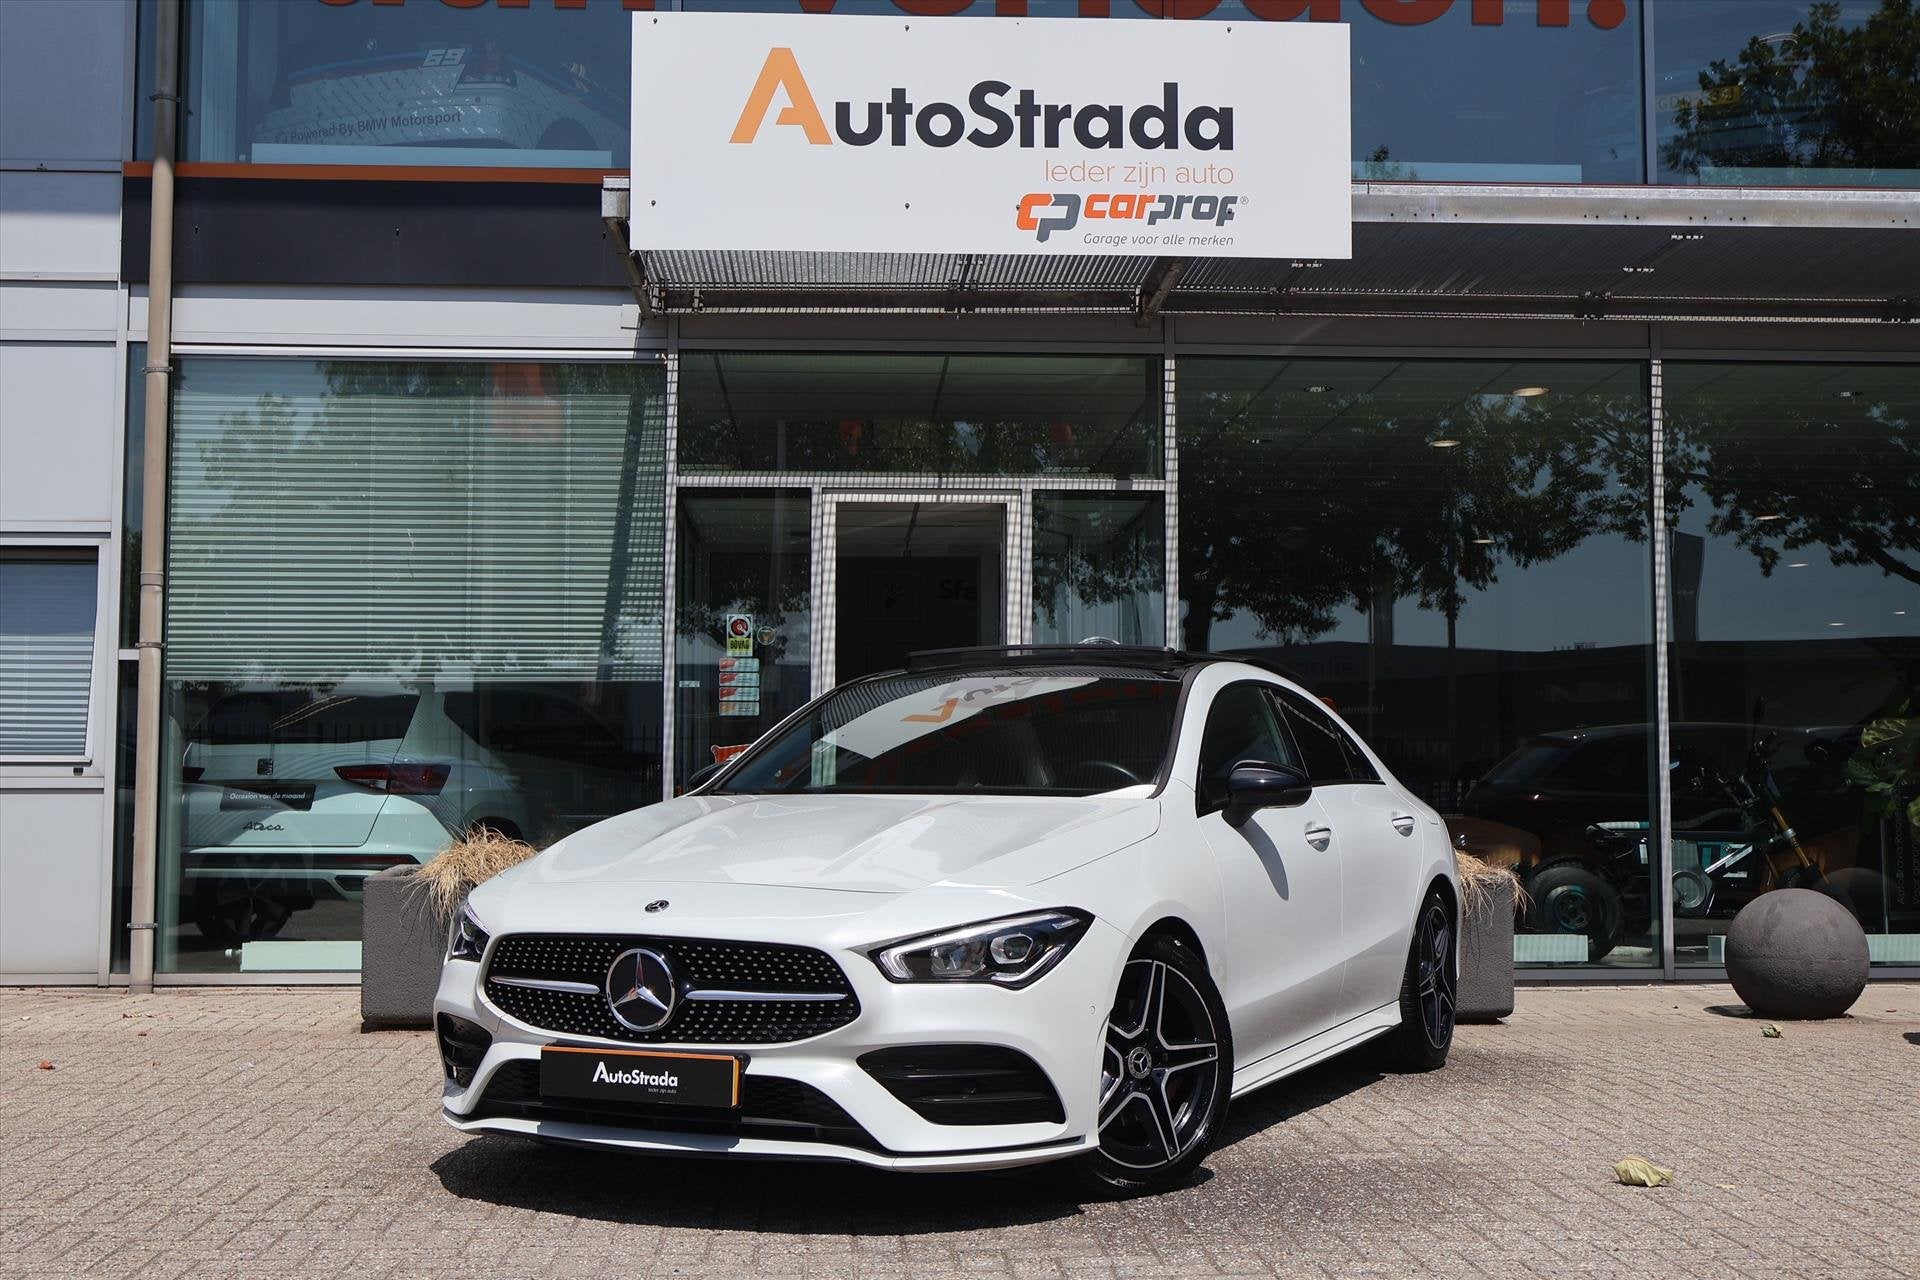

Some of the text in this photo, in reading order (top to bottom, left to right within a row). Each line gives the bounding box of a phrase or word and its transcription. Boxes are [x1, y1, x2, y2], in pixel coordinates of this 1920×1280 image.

[729, 47, 1234, 150] AutoStrada
[339, 123, 354, 136] By
[357, 117, 388, 132] BMW
[391, 112, 462, 129] Motorsport
[1045, 160, 1234, 188] Ieder zijn auto
[1083, 233, 1234, 247] Garage voor alle merken
[258, 792, 271, 800] van
[272, 791, 281, 800] de
[281, 791, 306, 800] maand
[242, 820, 285, 831] Ateca
[592, 1060, 678, 1087] AutoStrada
